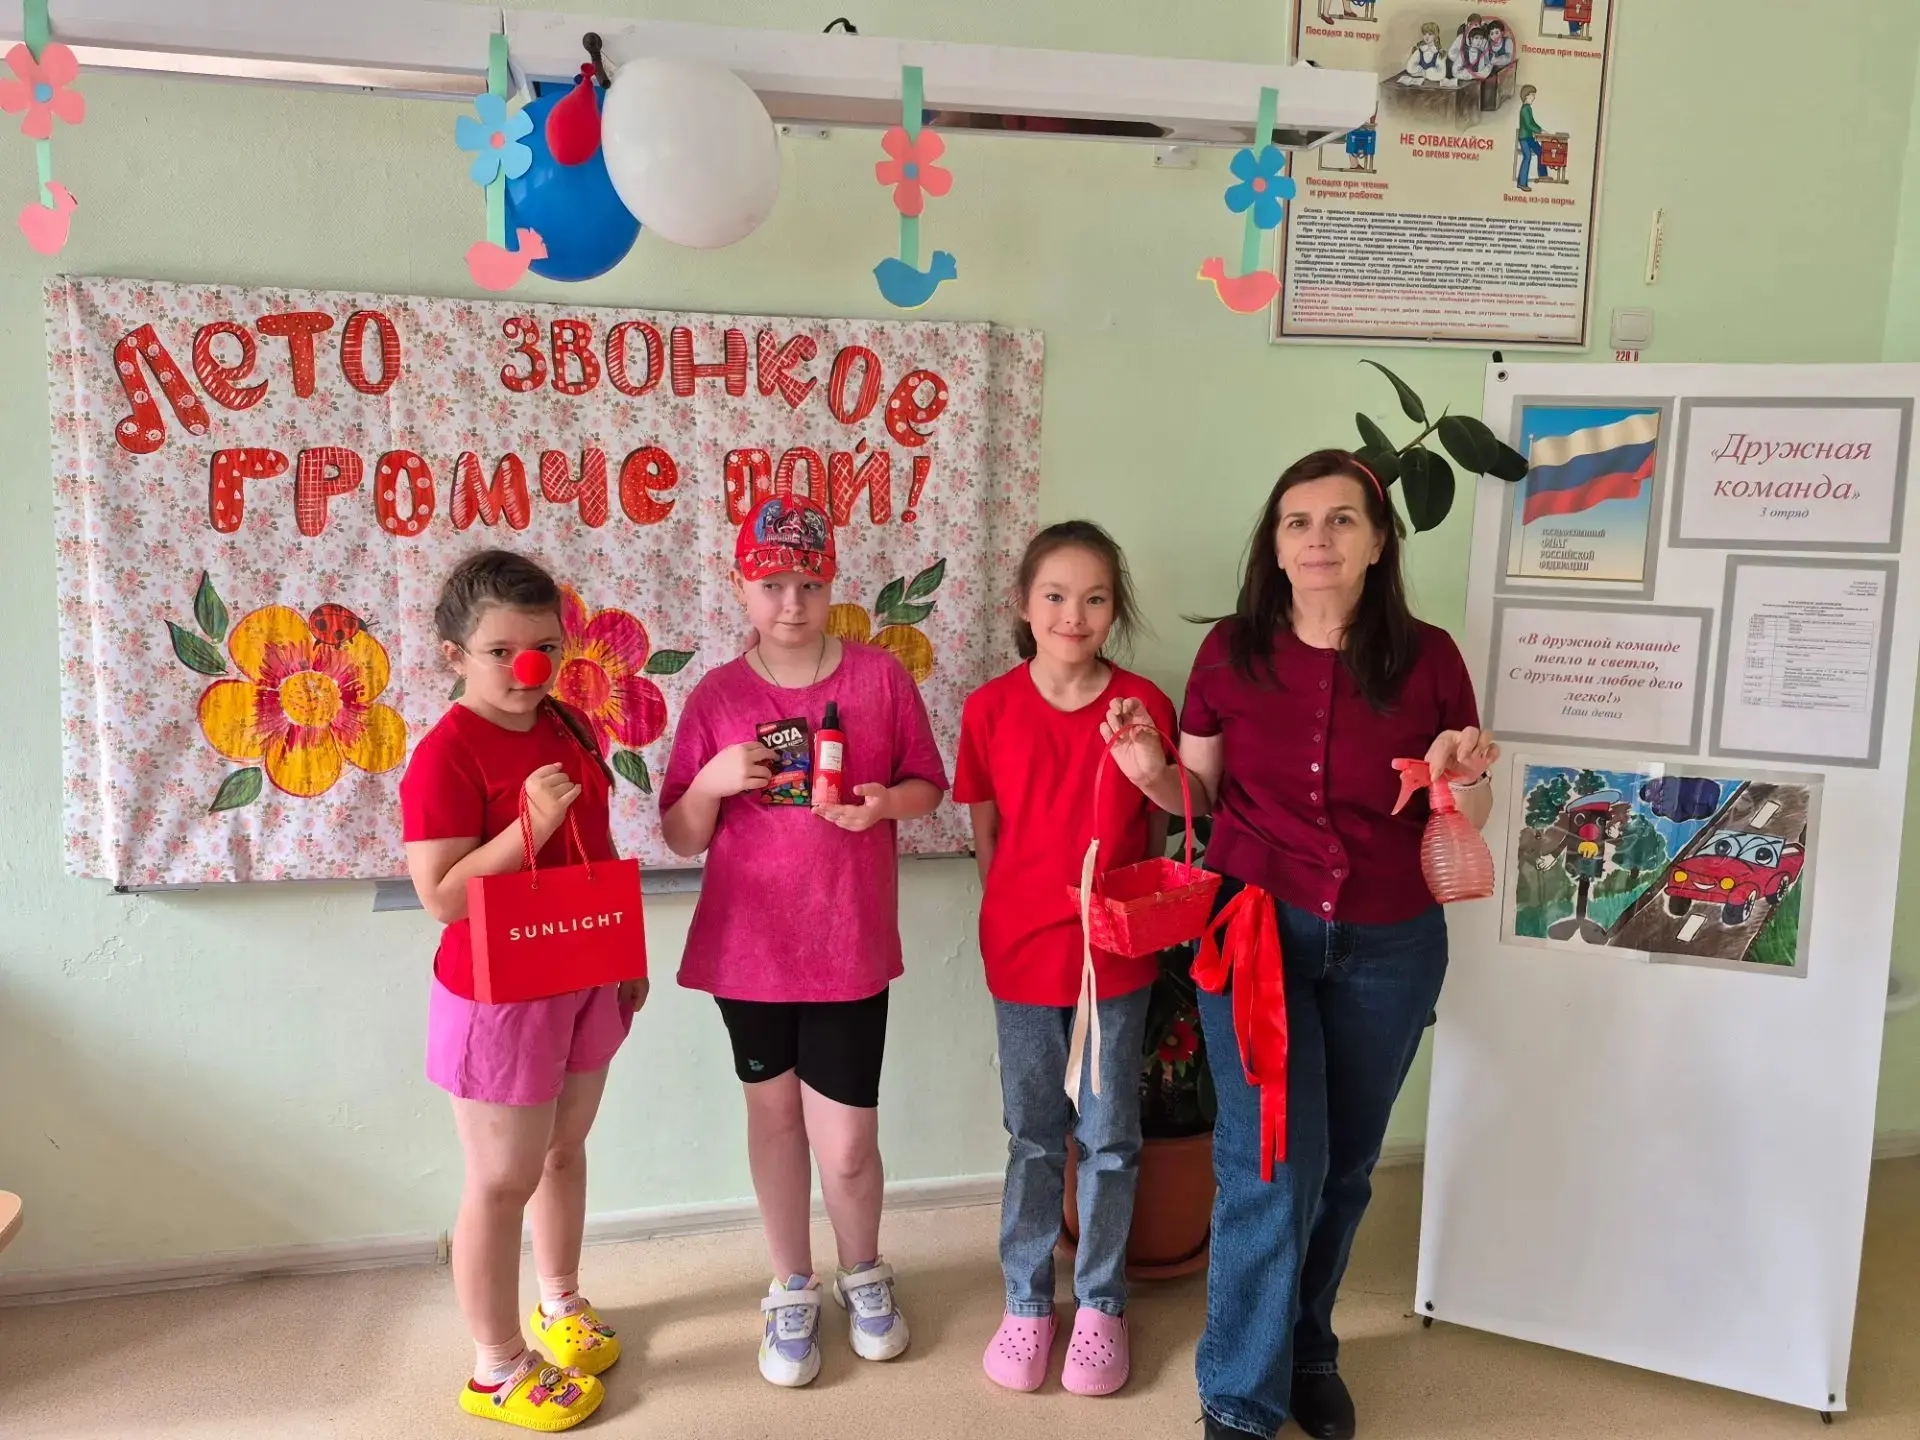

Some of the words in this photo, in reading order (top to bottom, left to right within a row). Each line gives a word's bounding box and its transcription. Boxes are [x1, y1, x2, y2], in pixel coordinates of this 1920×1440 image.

[1305, 26, 1342, 38] Посадка
[1356, 31, 1381, 42] парту
[1521, 44, 1556, 56] Посадка
[1557, 49, 1572, 58] при
[1400, 132, 1415, 145] НЕ
[1418, 134, 1494, 150] ОТВЛЕКАЙСЯ
[1425, 150, 1450, 159] ВРЕМЯ
[1306, 177, 1341, 187] Посадка
[1349, 191, 1383, 200] работах
[1503, 193, 1528, 203] Выход
[1615, 351, 1631, 362] 220
[1711, 433, 1873, 466] «Дружная
[1713, 473, 1860, 500] команда»
[1760, 506, 1767, 517] 3
[1769, 507, 1810, 520] отряд
[1518, 633, 1538, 645] «В
[1542, 633, 1612, 650] дружной
[1615, 640, 1681, 653] команде
[1534, 654, 1583, 666] тепло
[1587, 657, 1597, 666] и
[1600, 659, 1659, 672] светло,
[1509, 667, 1522, 680] С
[1524, 668, 1594, 685] друзьями
[1596, 672, 1646, 688] любое
[1648, 678, 1684, 690] дело
[1564, 690, 1622, 704] легко!»
[1561, 705, 1589, 717] Наш
[1591, 707, 1624, 719] девиз
[762, 727, 803, 747] YOTA
[509, 911, 624, 941] SUNLIGHT
